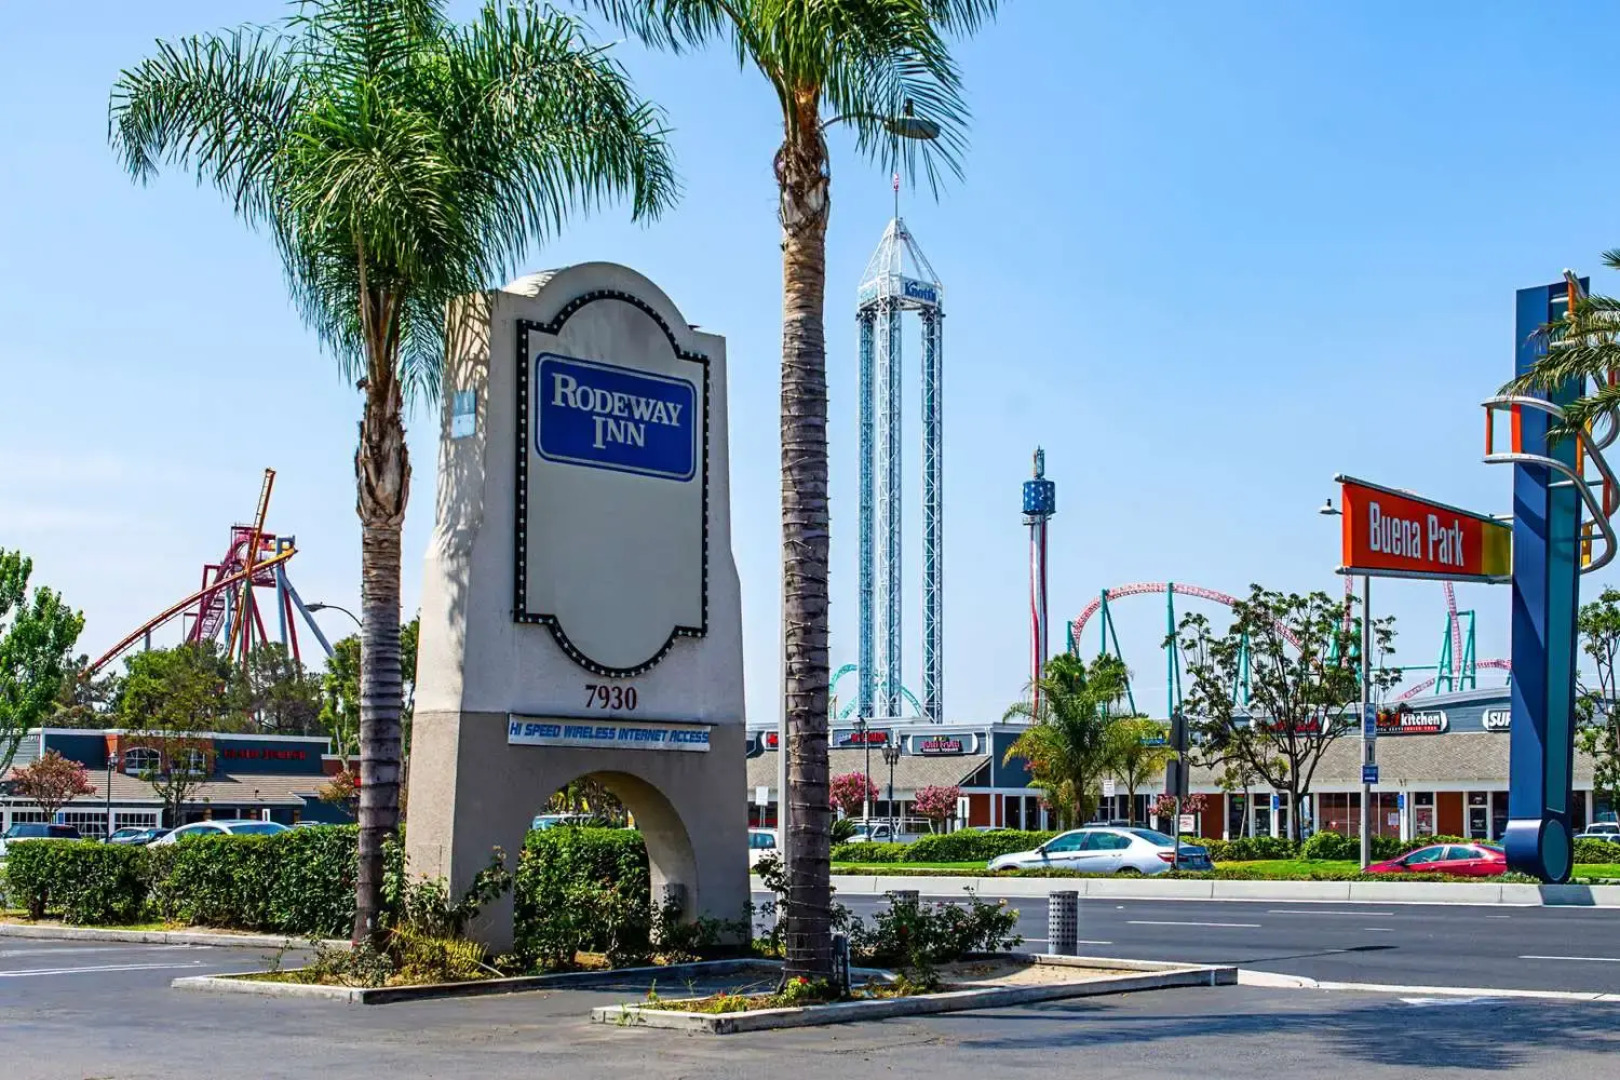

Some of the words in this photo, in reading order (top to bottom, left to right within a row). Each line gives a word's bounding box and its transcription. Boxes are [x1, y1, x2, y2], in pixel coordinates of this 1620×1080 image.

[551, 372, 682, 427] RODEWAY
[592, 415, 646, 449] INN
[1369, 501, 1421, 560] Buena
[1427, 514, 1464, 567] Park
[585, 684, 637, 711] 7930
[510, 722, 522, 735] HI
[525, 723, 561, 738] SPEED
[563, 725, 616, 739] WIRELESS
[617, 727, 668, 742] INTERNET
[669, 730, 710, 744] ACCESS
[1400, 711, 1440, 726] kitchen
